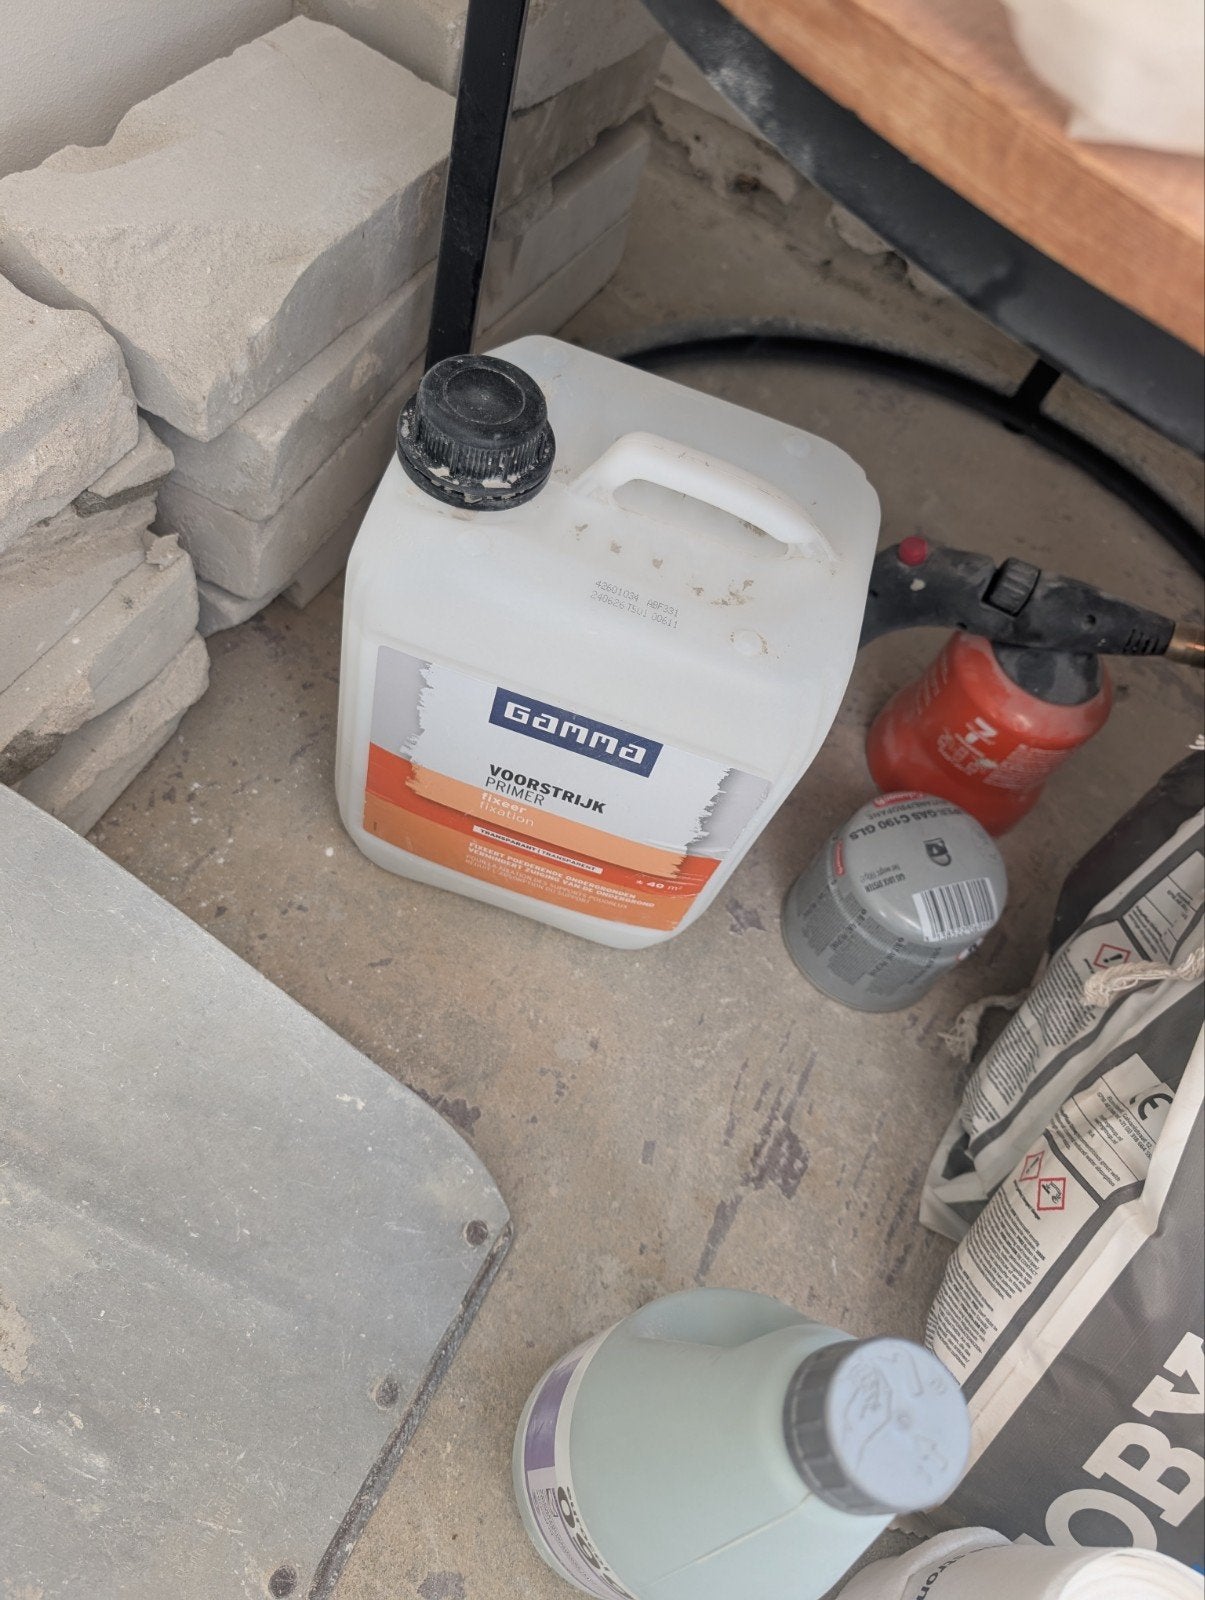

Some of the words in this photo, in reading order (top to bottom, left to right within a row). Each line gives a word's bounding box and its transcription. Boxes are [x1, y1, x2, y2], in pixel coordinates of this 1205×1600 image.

[485, 776, 545, 806] PRIMER
[489, 763, 606, 813] VOORSTRIJK
[479, 801, 534, 827] fixation
[481, 791, 527, 814] fixeer
[848, 824, 876, 840] GLS
[877, 814, 911, 830] C190
[480, 828, 537, 853] TRANSPARANT
[646, 881, 665, 889] 40
